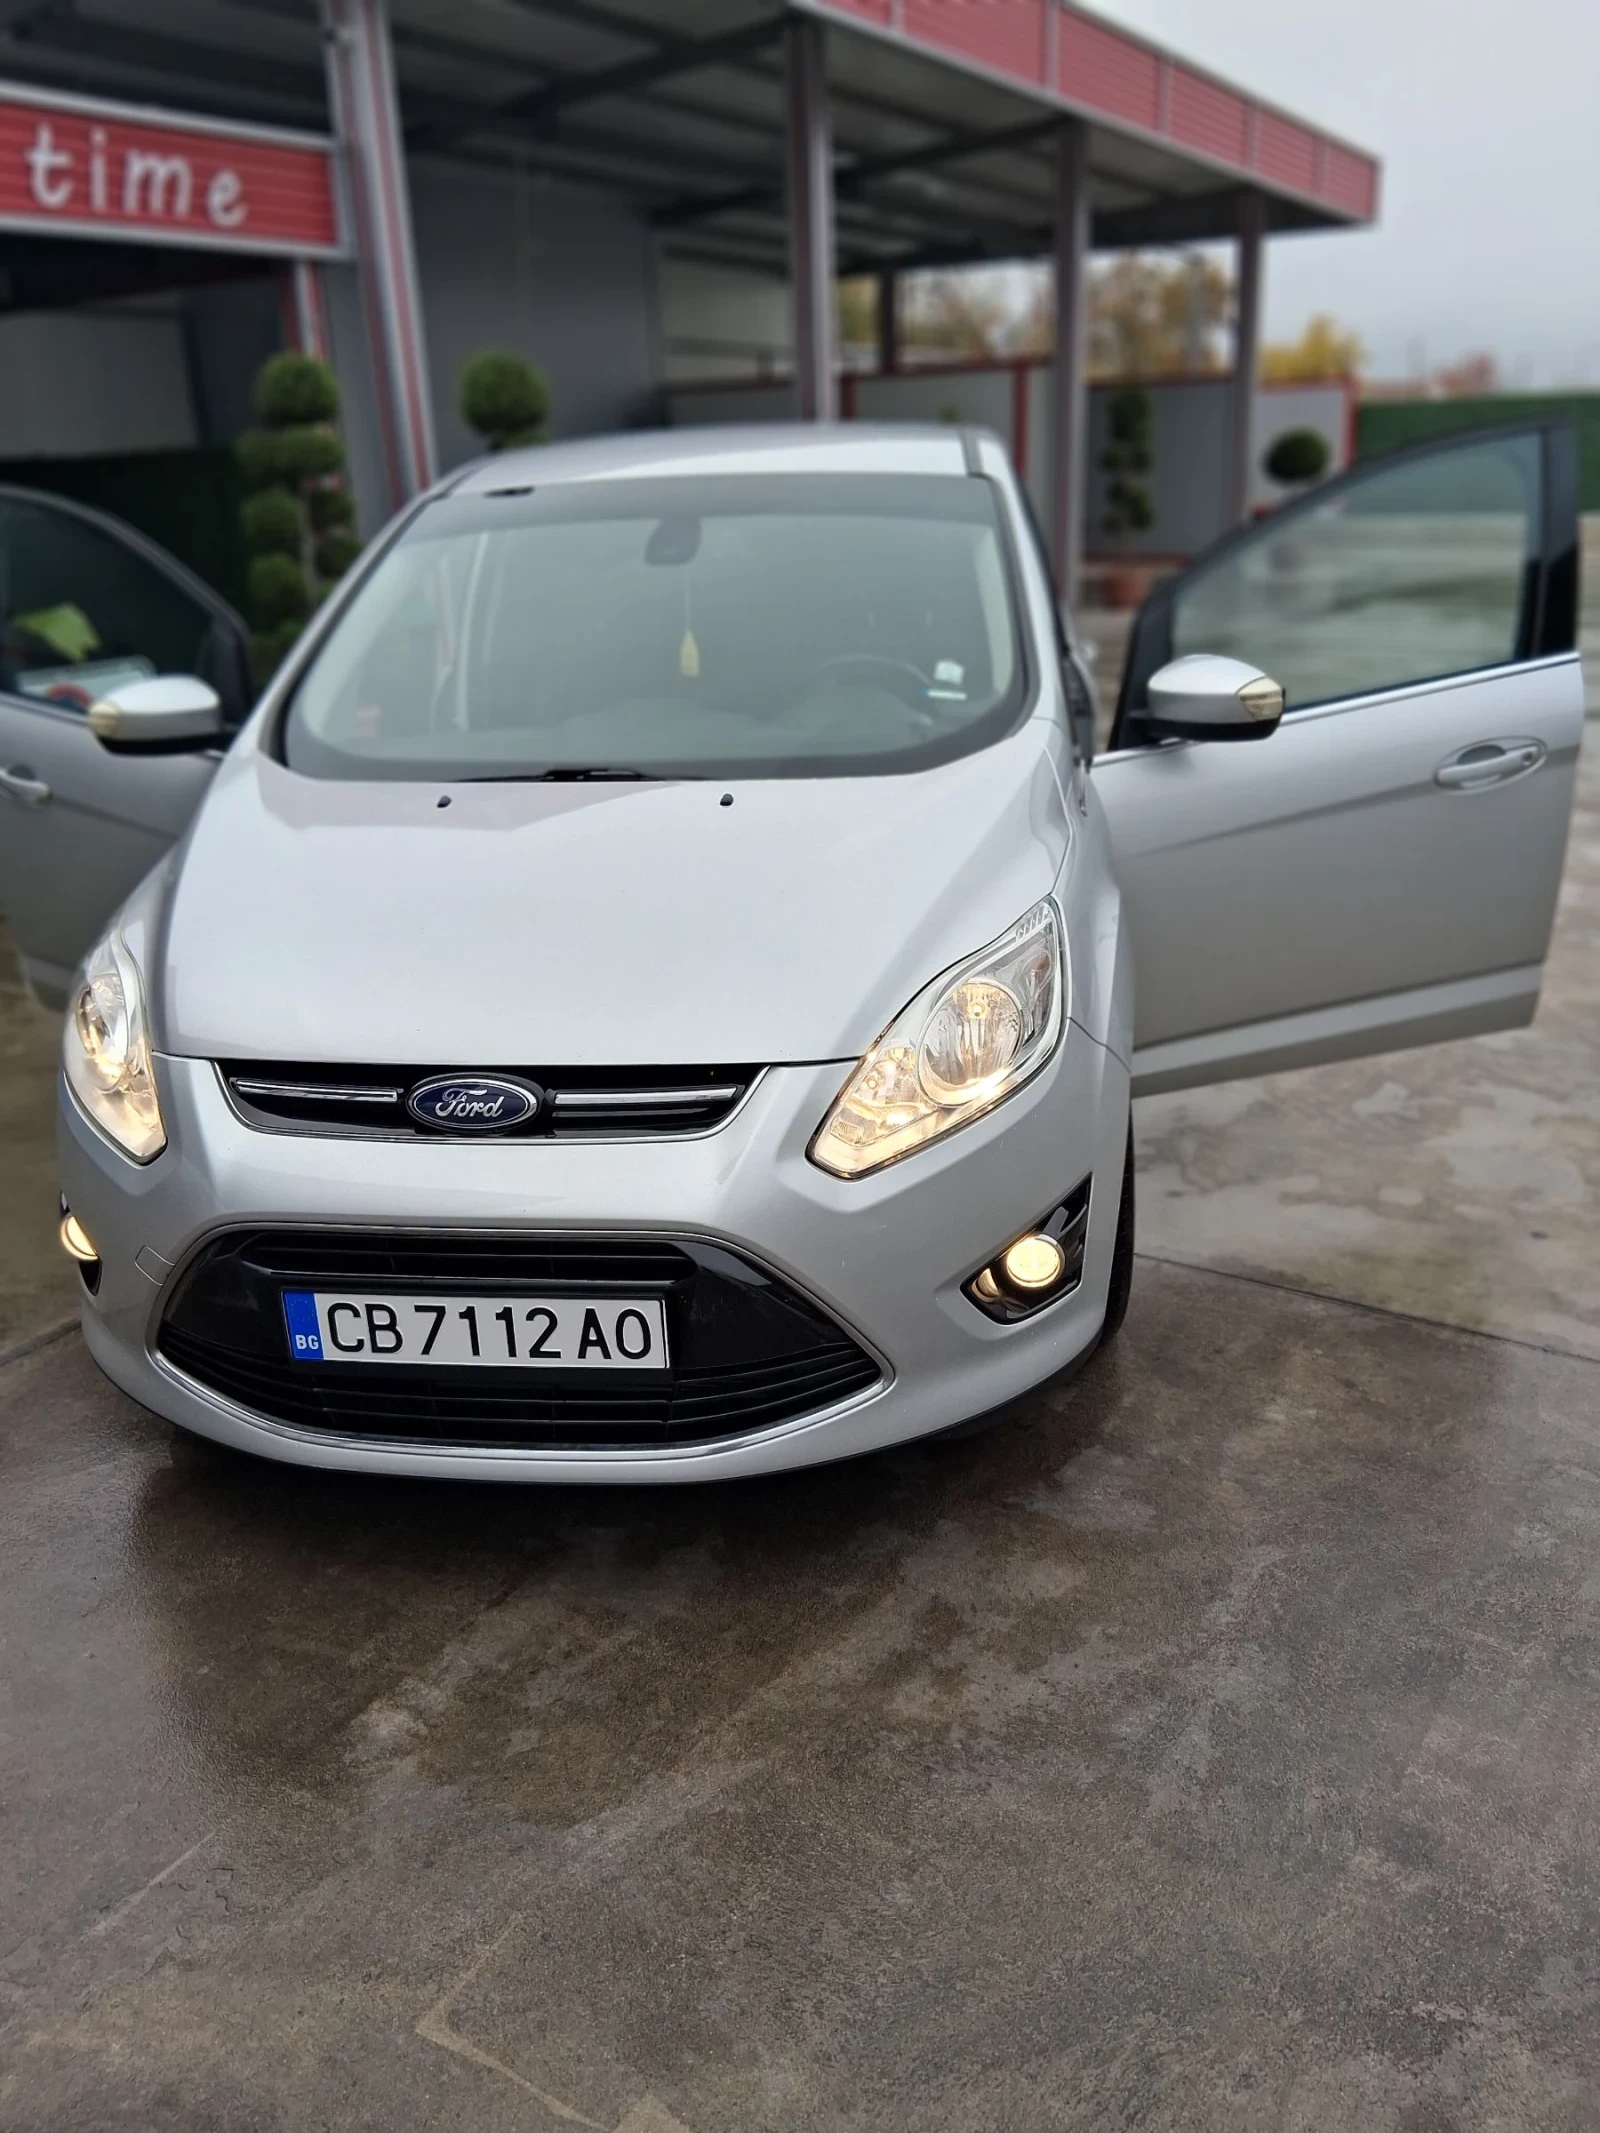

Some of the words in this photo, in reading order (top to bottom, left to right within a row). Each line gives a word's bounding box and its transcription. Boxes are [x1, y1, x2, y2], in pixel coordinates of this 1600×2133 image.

[25, 122, 248, 228] time
[435, 1088, 505, 1117] Ford
[295, 1334, 319, 1350] BG
[326, 1302, 403, 1354] CB
[413, 1304, 562, 1359] 7112
